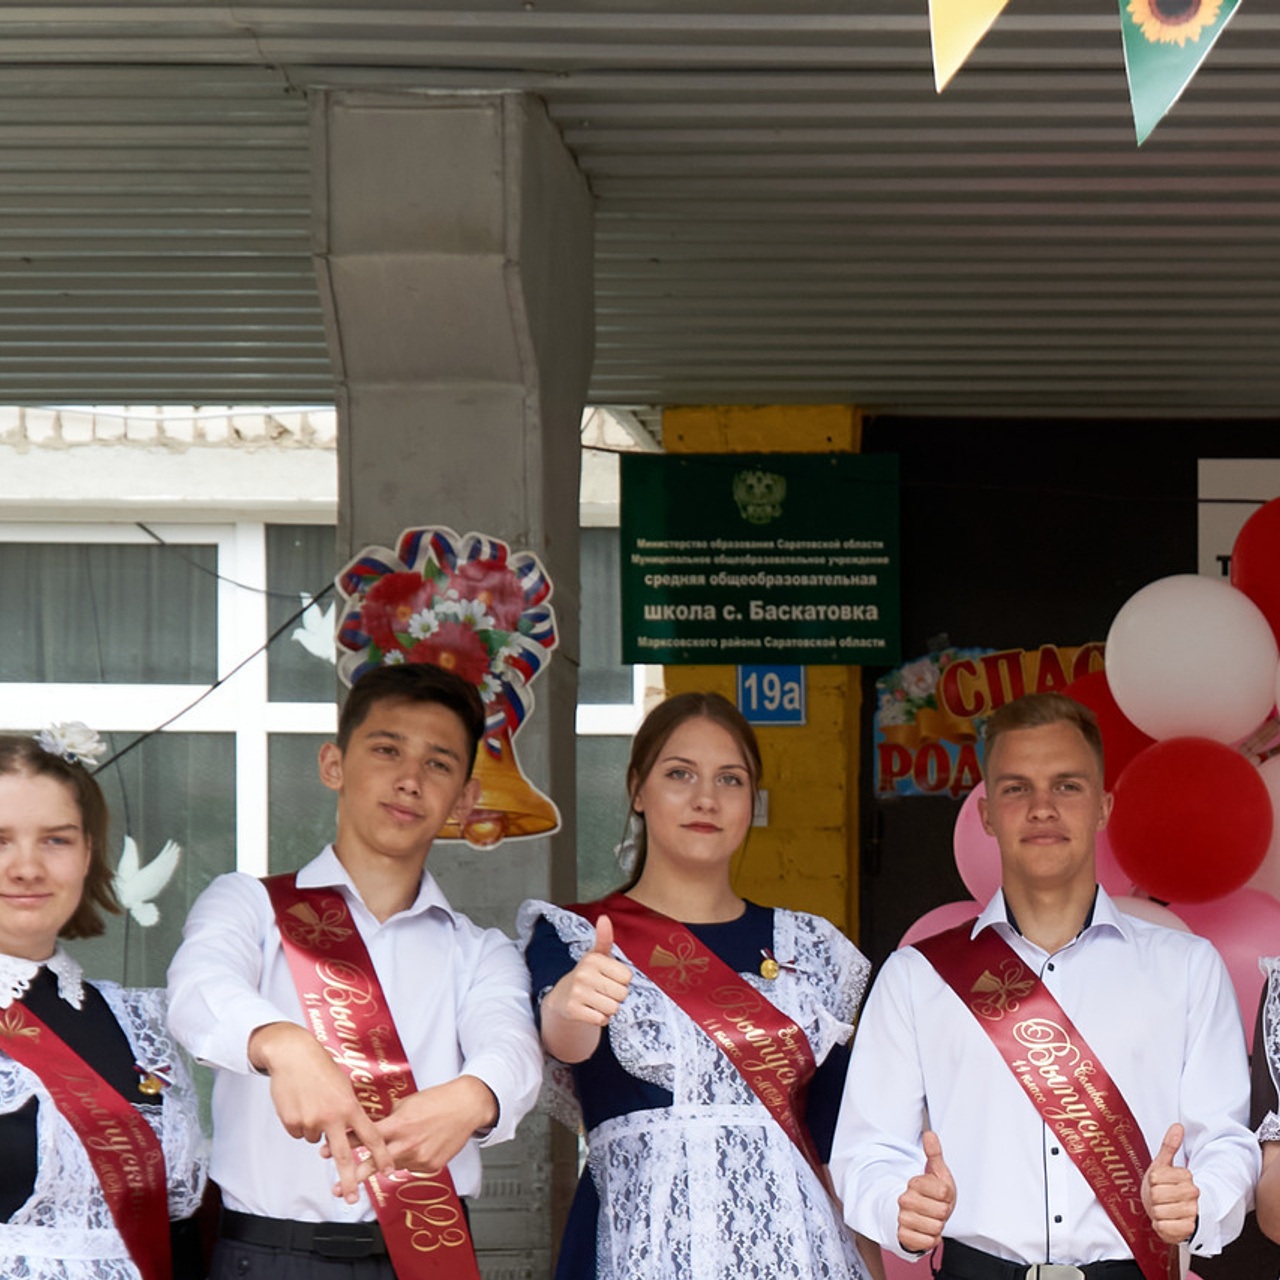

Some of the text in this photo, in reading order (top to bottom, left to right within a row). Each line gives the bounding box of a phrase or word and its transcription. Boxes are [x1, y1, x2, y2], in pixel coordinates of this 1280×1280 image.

[644, 572, 877, 588] средняя общеобразовательная
[644, 601, 878, 620] школа с. Баскатовка
[720, 636, 761, 649] района
[764, 636, 836, 649] Саратовской
[839, 636, 885, 648] области
[744, 672, 801, 711] 19а
[1012, 1060, 1029, 1073] 11
[1021, 1072, 1047, 1104] класс
[1012, 1017, 1138, 1196] Выпускник
